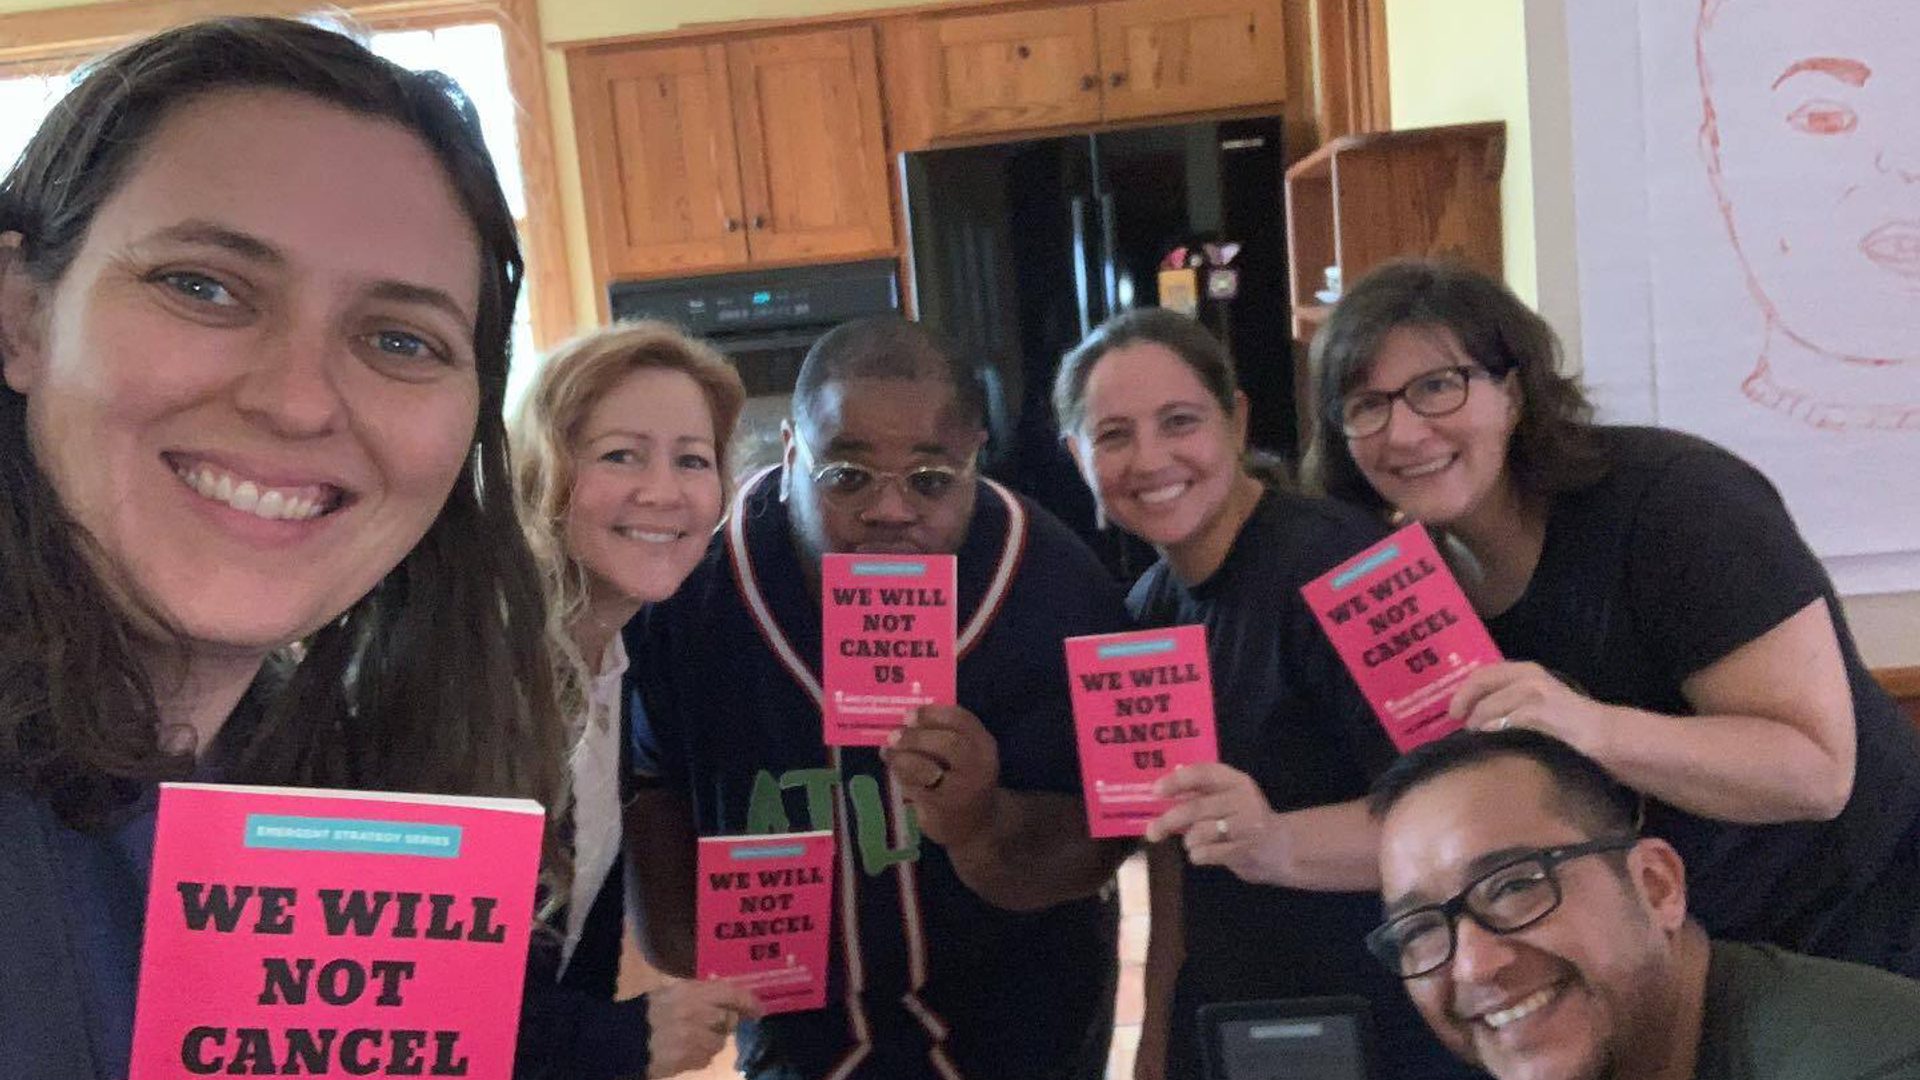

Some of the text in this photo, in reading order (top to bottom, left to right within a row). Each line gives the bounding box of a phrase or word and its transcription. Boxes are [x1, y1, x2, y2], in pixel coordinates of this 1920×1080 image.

[832, 588, 946, 606] WE WILL
[1327, 595, 1369, 625] WE
[1367, 559, 1436, 601] WILL
[863, 614, 915, 632] NOT
[1366, 595, 1419, 635] NOT
[840, 640, 939, 658] CANCEL
[1362, 607, 1459, 668] CANCEL
[1405, 646, 1439, 674] US
[874, 665, 905, 683] US
[1080, 663, 1201, 692] WE WILL
[1115, 693, 1170, 717] NOT
[1094, 718, 1200, 744] CANCEL
[1133, 749, 1165, 770] US
[257, 826, 450, 847] EMERGENT STRATEGY SERIES
[709, 867, 823, 891] WE WILL
[177, 882, 507, 943] WE WILL
[739, 894, 794, 913] NOT
[715, 915, 814, 940] CANCEL
[750, 942, 780, 961] US
[257, 958, 416, 1007] NOT
[181, 1026, 468, 1076] CANCEL
